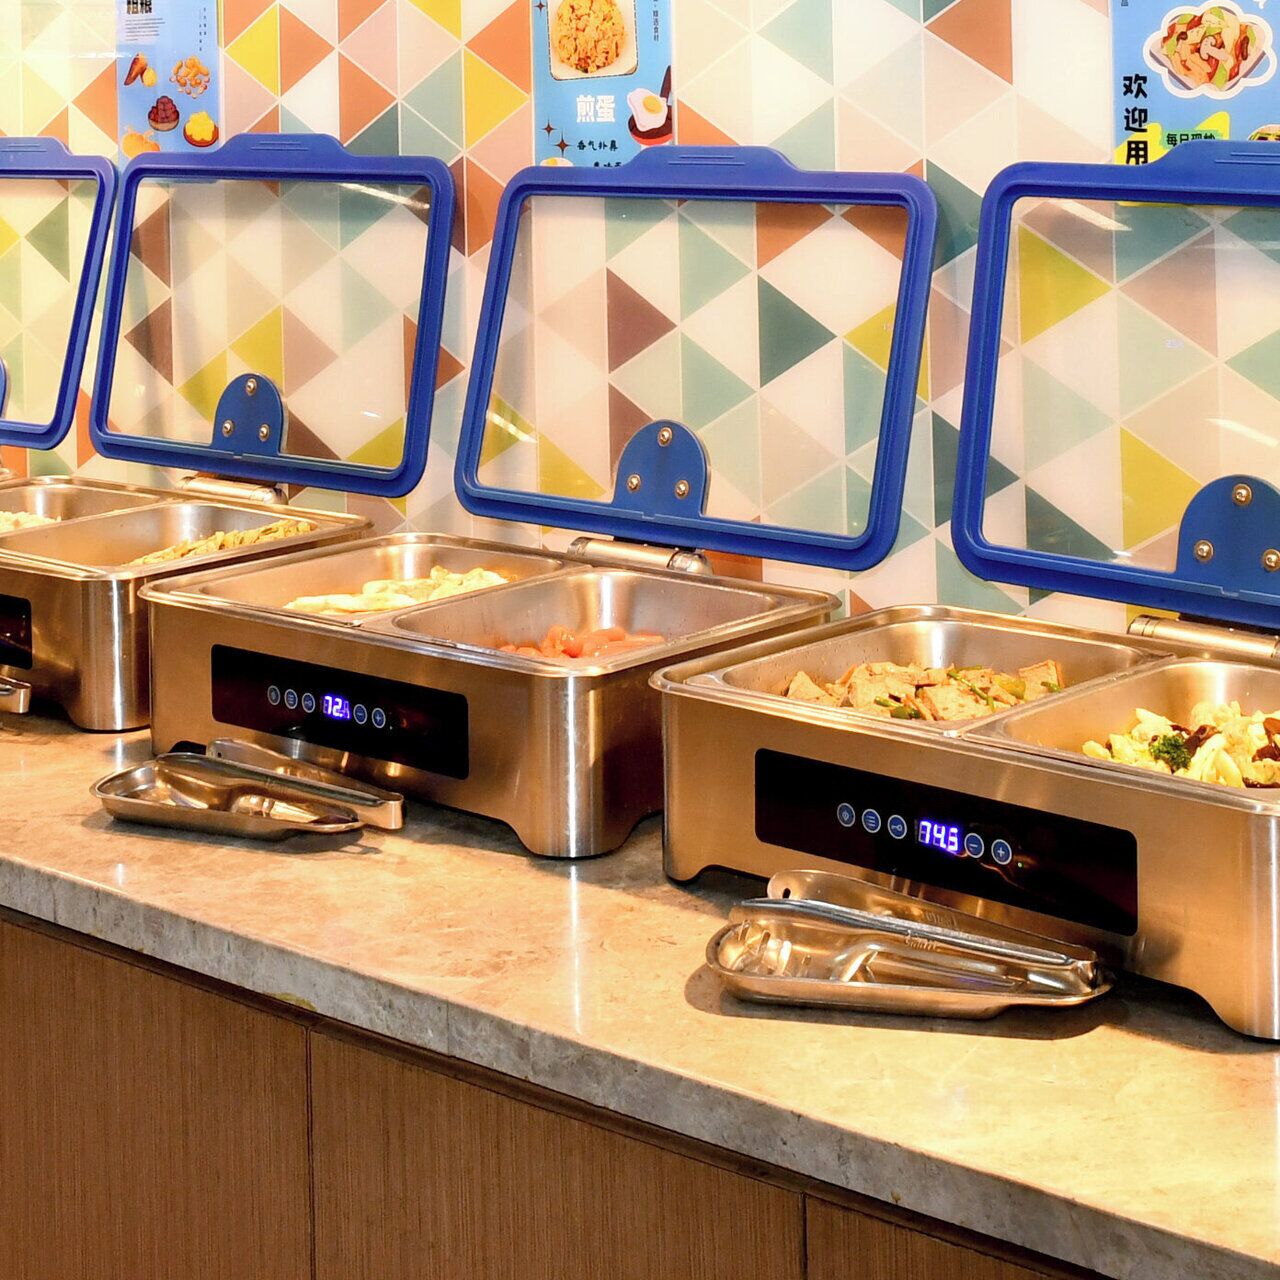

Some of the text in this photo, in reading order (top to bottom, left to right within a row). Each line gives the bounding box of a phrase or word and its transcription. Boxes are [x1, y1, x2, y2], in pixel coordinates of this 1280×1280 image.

[576, 94, 615, 123] 煎蛋
[576, 139, 619, 152] 香气扑鼻
